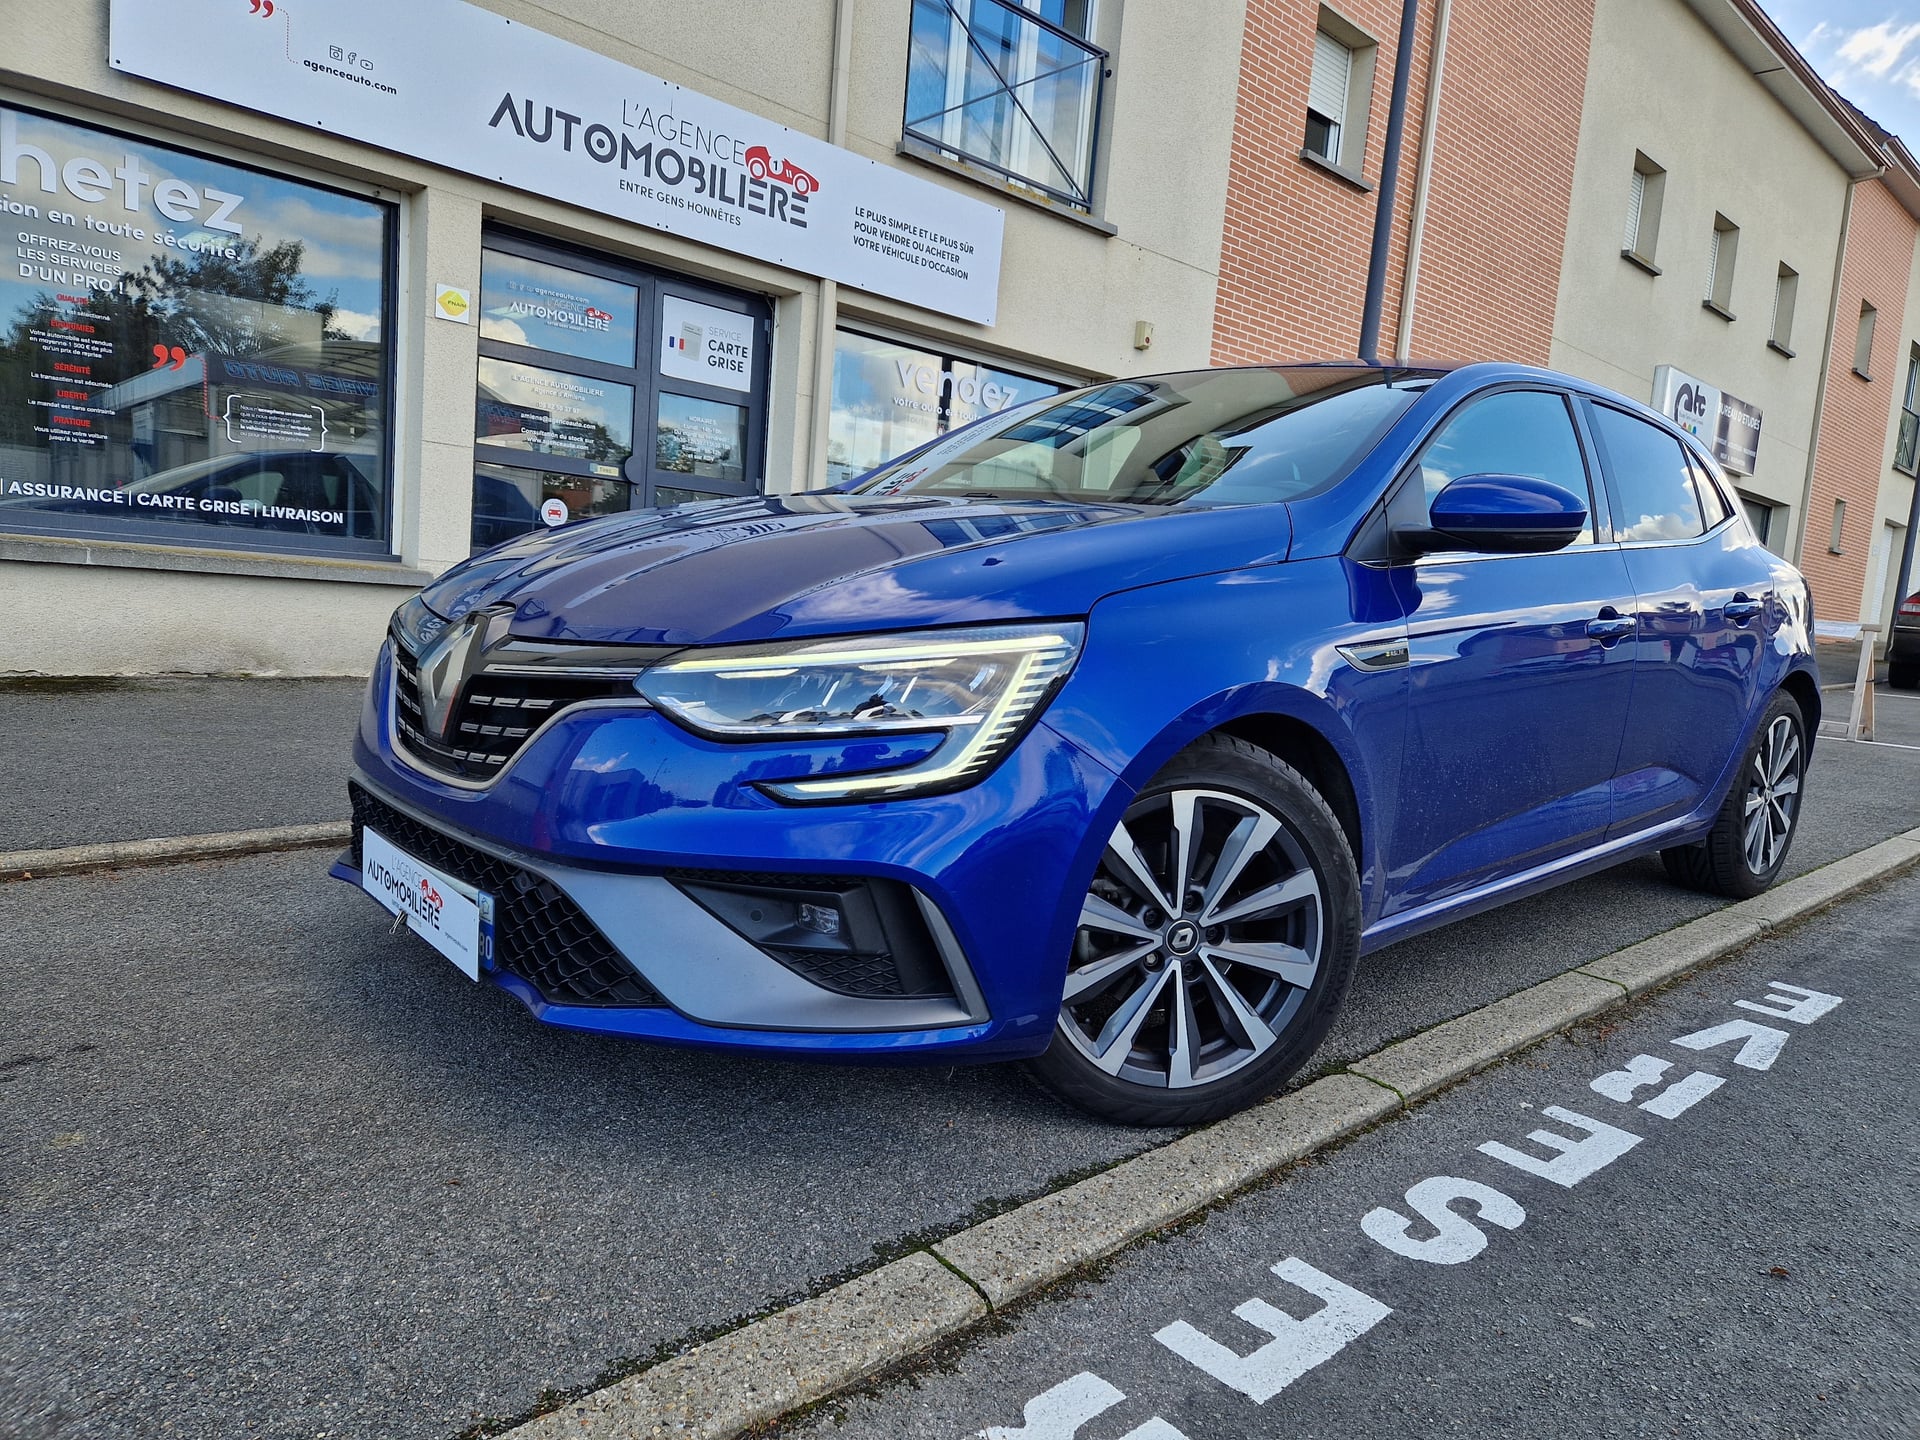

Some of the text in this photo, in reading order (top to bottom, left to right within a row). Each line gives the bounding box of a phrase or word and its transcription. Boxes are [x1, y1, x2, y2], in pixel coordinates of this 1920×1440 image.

[303, 60, 397, 95] agenceauto.com
[622, 98, 746, 166] L'AGENCE
[619, 179, 742, 226] ENTRE GENS HONNÊTES
[48, 210, 76, 226] en
[84, 214, 145, 241] toute
[153, 229, 242, 261] sécurité.
[854, 221, 960, 264] POUR VENDRE OU ACHETER
[855, 205, 975, 255] LE PLUS SIMPLE ET LE PLUS SÛR
[17, 231, 121, 261] OFFREZ-VOUS
[17, 246, 122, 276] LES SERVICES
[853, 235, 969, 280] VOTRE VÉHICULE D'OCCASION
[19, 263, 67, 285] D'UN
[72, 272, 113, 292] PRO
[534, 287, 590, 304] agenceauto.com
[30, 329, 46, 337] Votre
[47, 332, 80, 342] automobile
[90, 338, 113, 347] vendue
[708, 326, 742, 342] SERVICE
[708, 339, 749, 359] CARTE
[707, 355, 744, 373] GRISE
[895, 360, 1020, 410] vendez
[893, 396, 919, 409] votre
[1718, 402, 1738, 420] UREAU
[8, 481, 344, 525] ASSURANCE CARTE GRISE LIVRAISON
